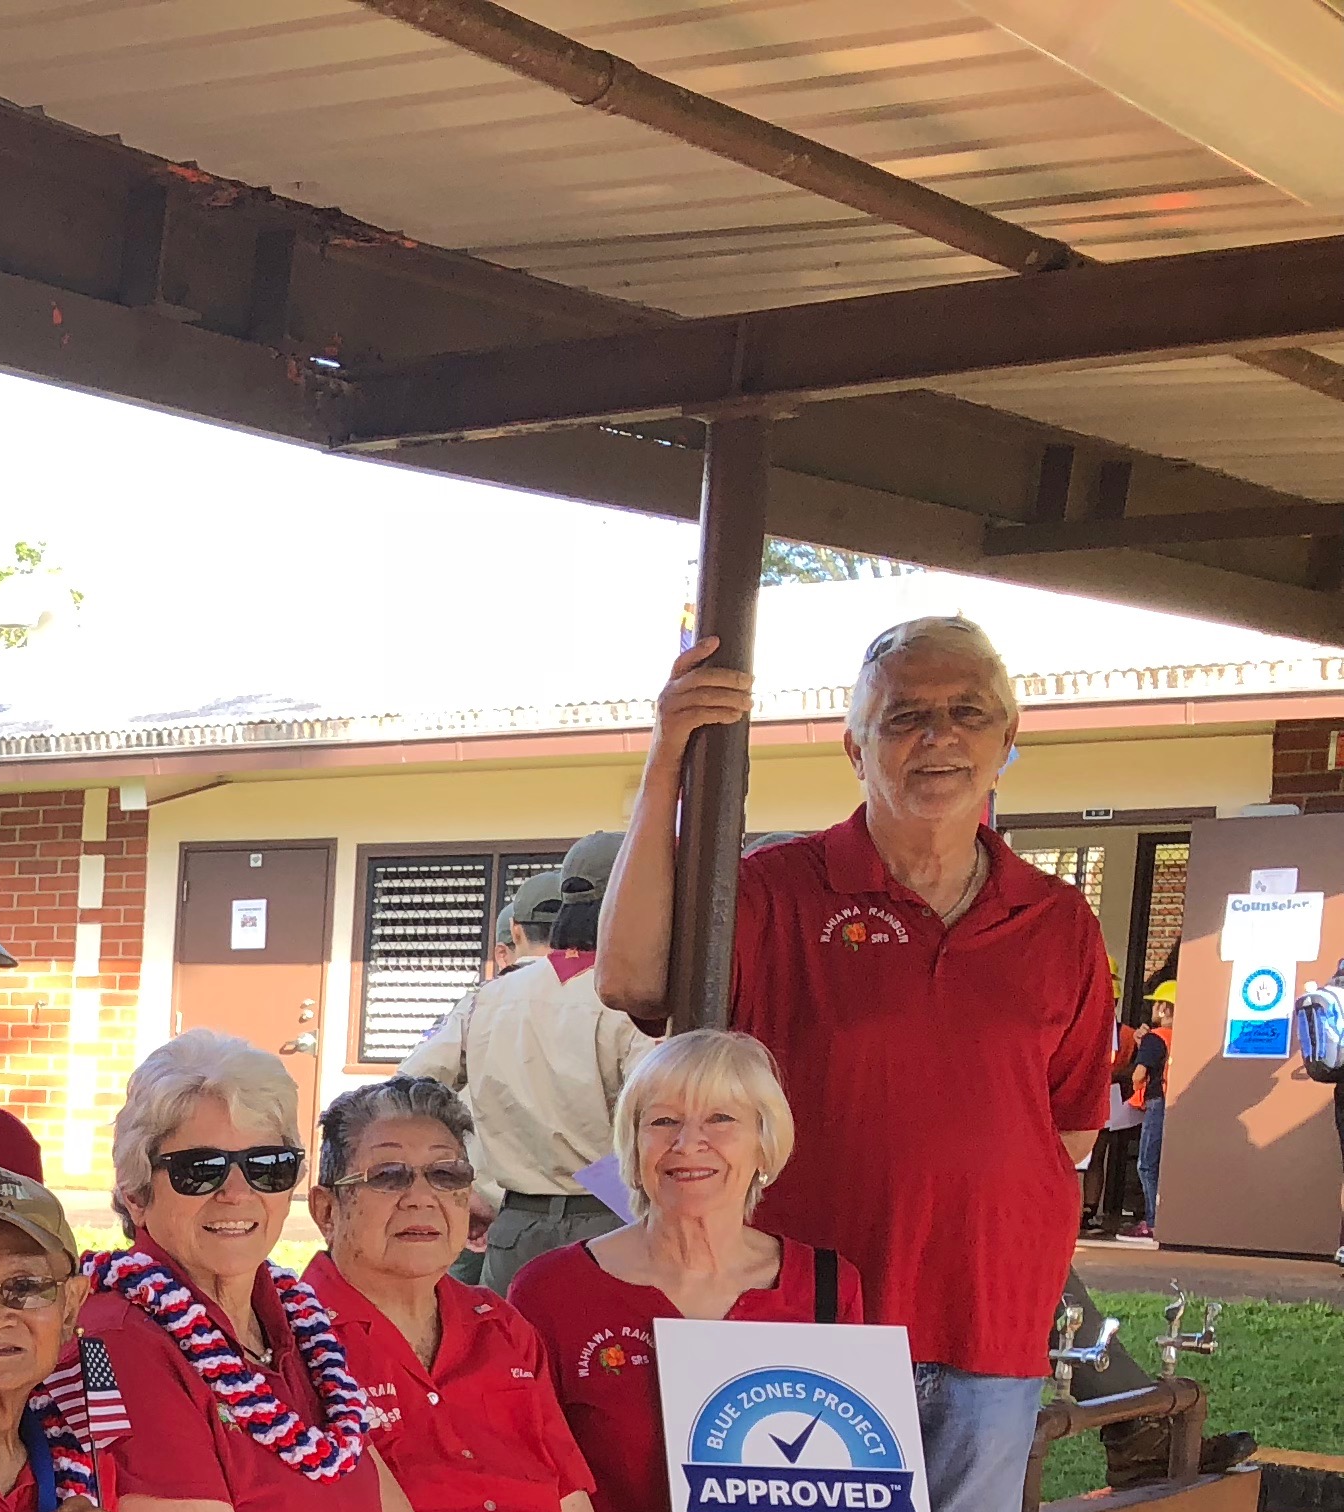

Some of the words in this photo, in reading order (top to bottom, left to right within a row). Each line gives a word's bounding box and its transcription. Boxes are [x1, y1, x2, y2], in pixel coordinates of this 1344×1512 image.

[820, 905, 861, 943] WAHIAWA
[868, 906, 909, 944] RAINBOW
[578, 1328, 614, 1378] WAHIAWA
[631, 1354, 649, 1365] SRS
[706, 1403, 741, 1450] BLUE
[737, 1382, 806, 1410] ZONES
[813, 1387, 887, 1457] PROJECT
